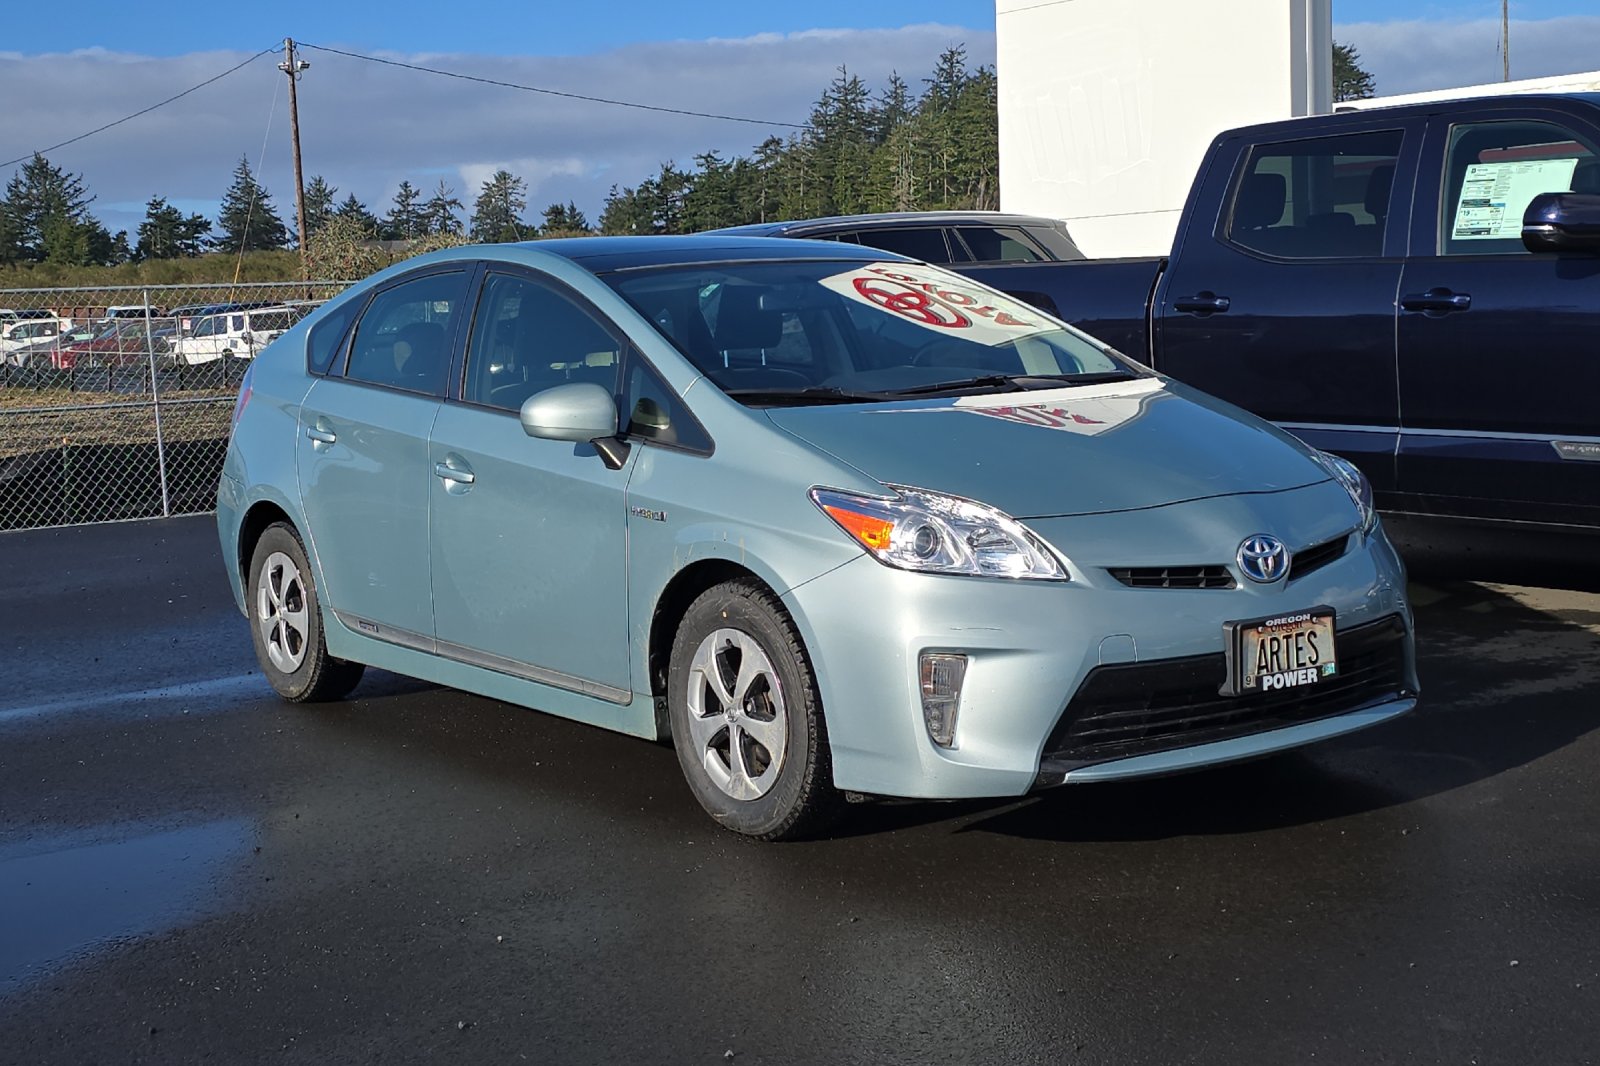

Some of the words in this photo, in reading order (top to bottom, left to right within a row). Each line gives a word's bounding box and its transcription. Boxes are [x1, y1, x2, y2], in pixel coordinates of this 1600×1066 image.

[1265, 613, 1311, 627] OREGON
[1257, 630, 1319, 675] ARTES
[1262, 668, 1318, 691] POWER
